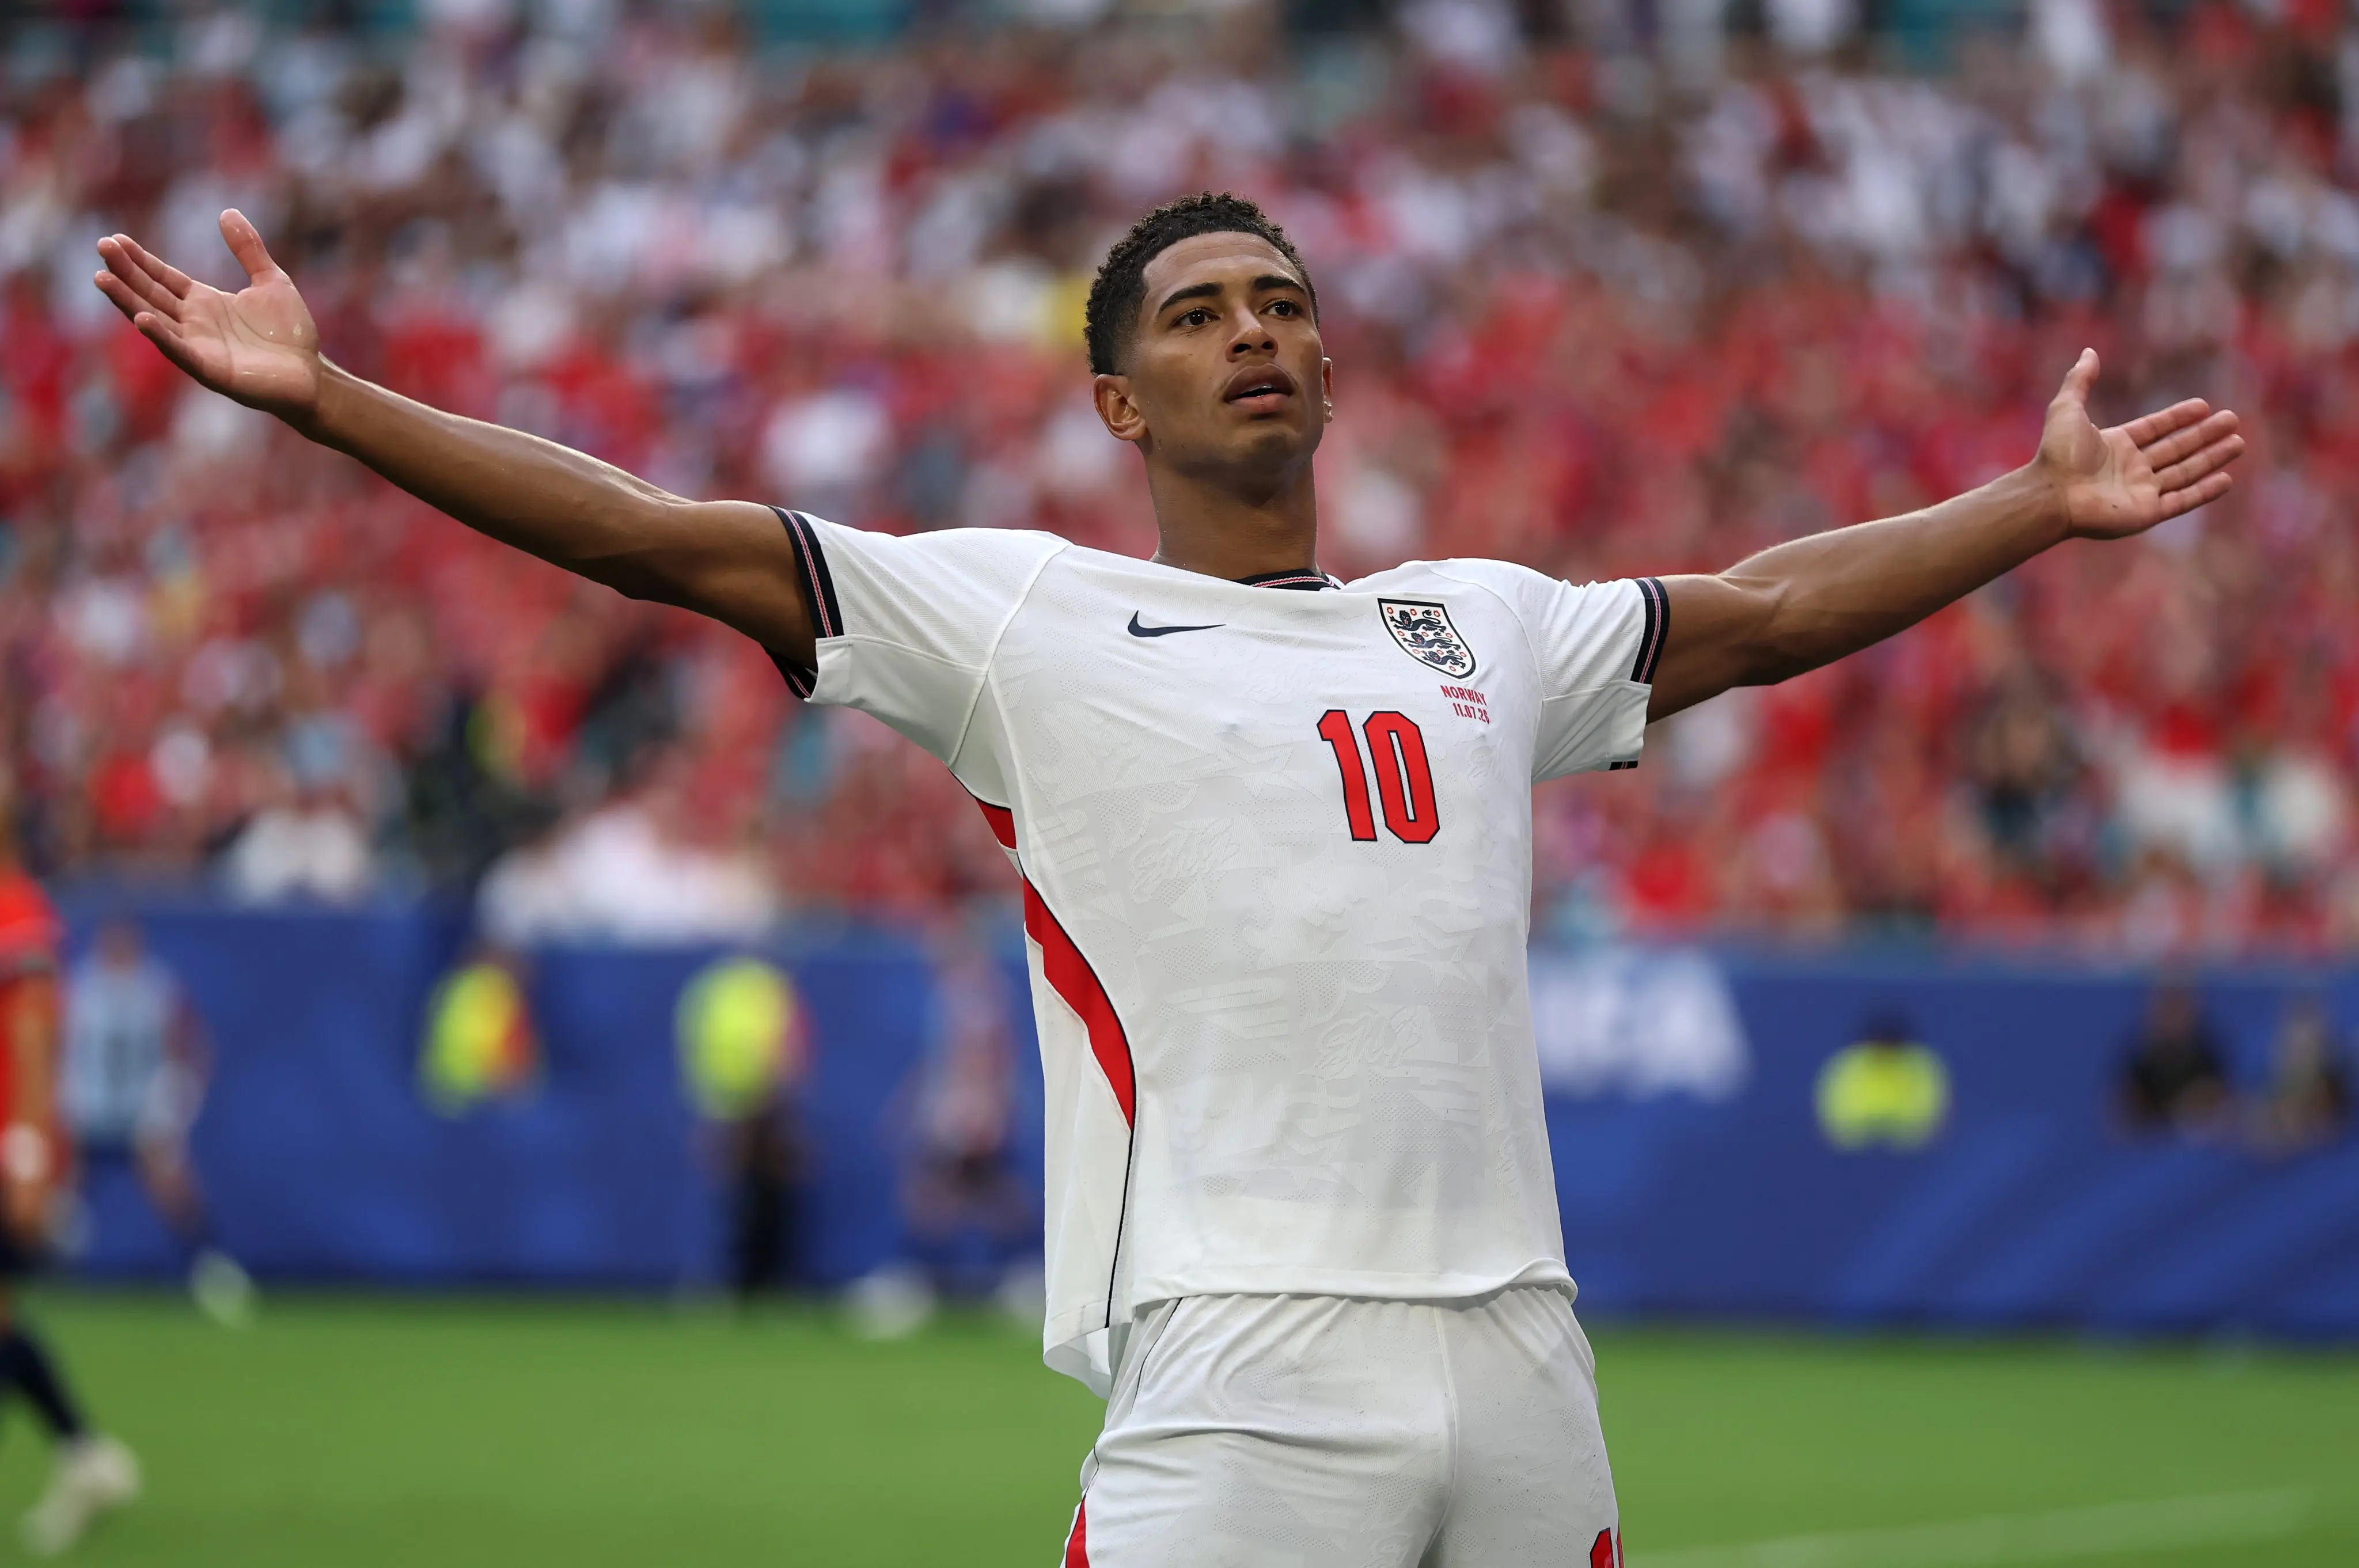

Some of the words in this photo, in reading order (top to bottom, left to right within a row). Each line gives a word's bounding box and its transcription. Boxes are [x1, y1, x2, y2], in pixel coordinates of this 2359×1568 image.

[1439, 684, 1487, 706] NORWAY
[1452, 702, 1490, 724] 11.07.26
[1316, 709, 1440, 844] 10
